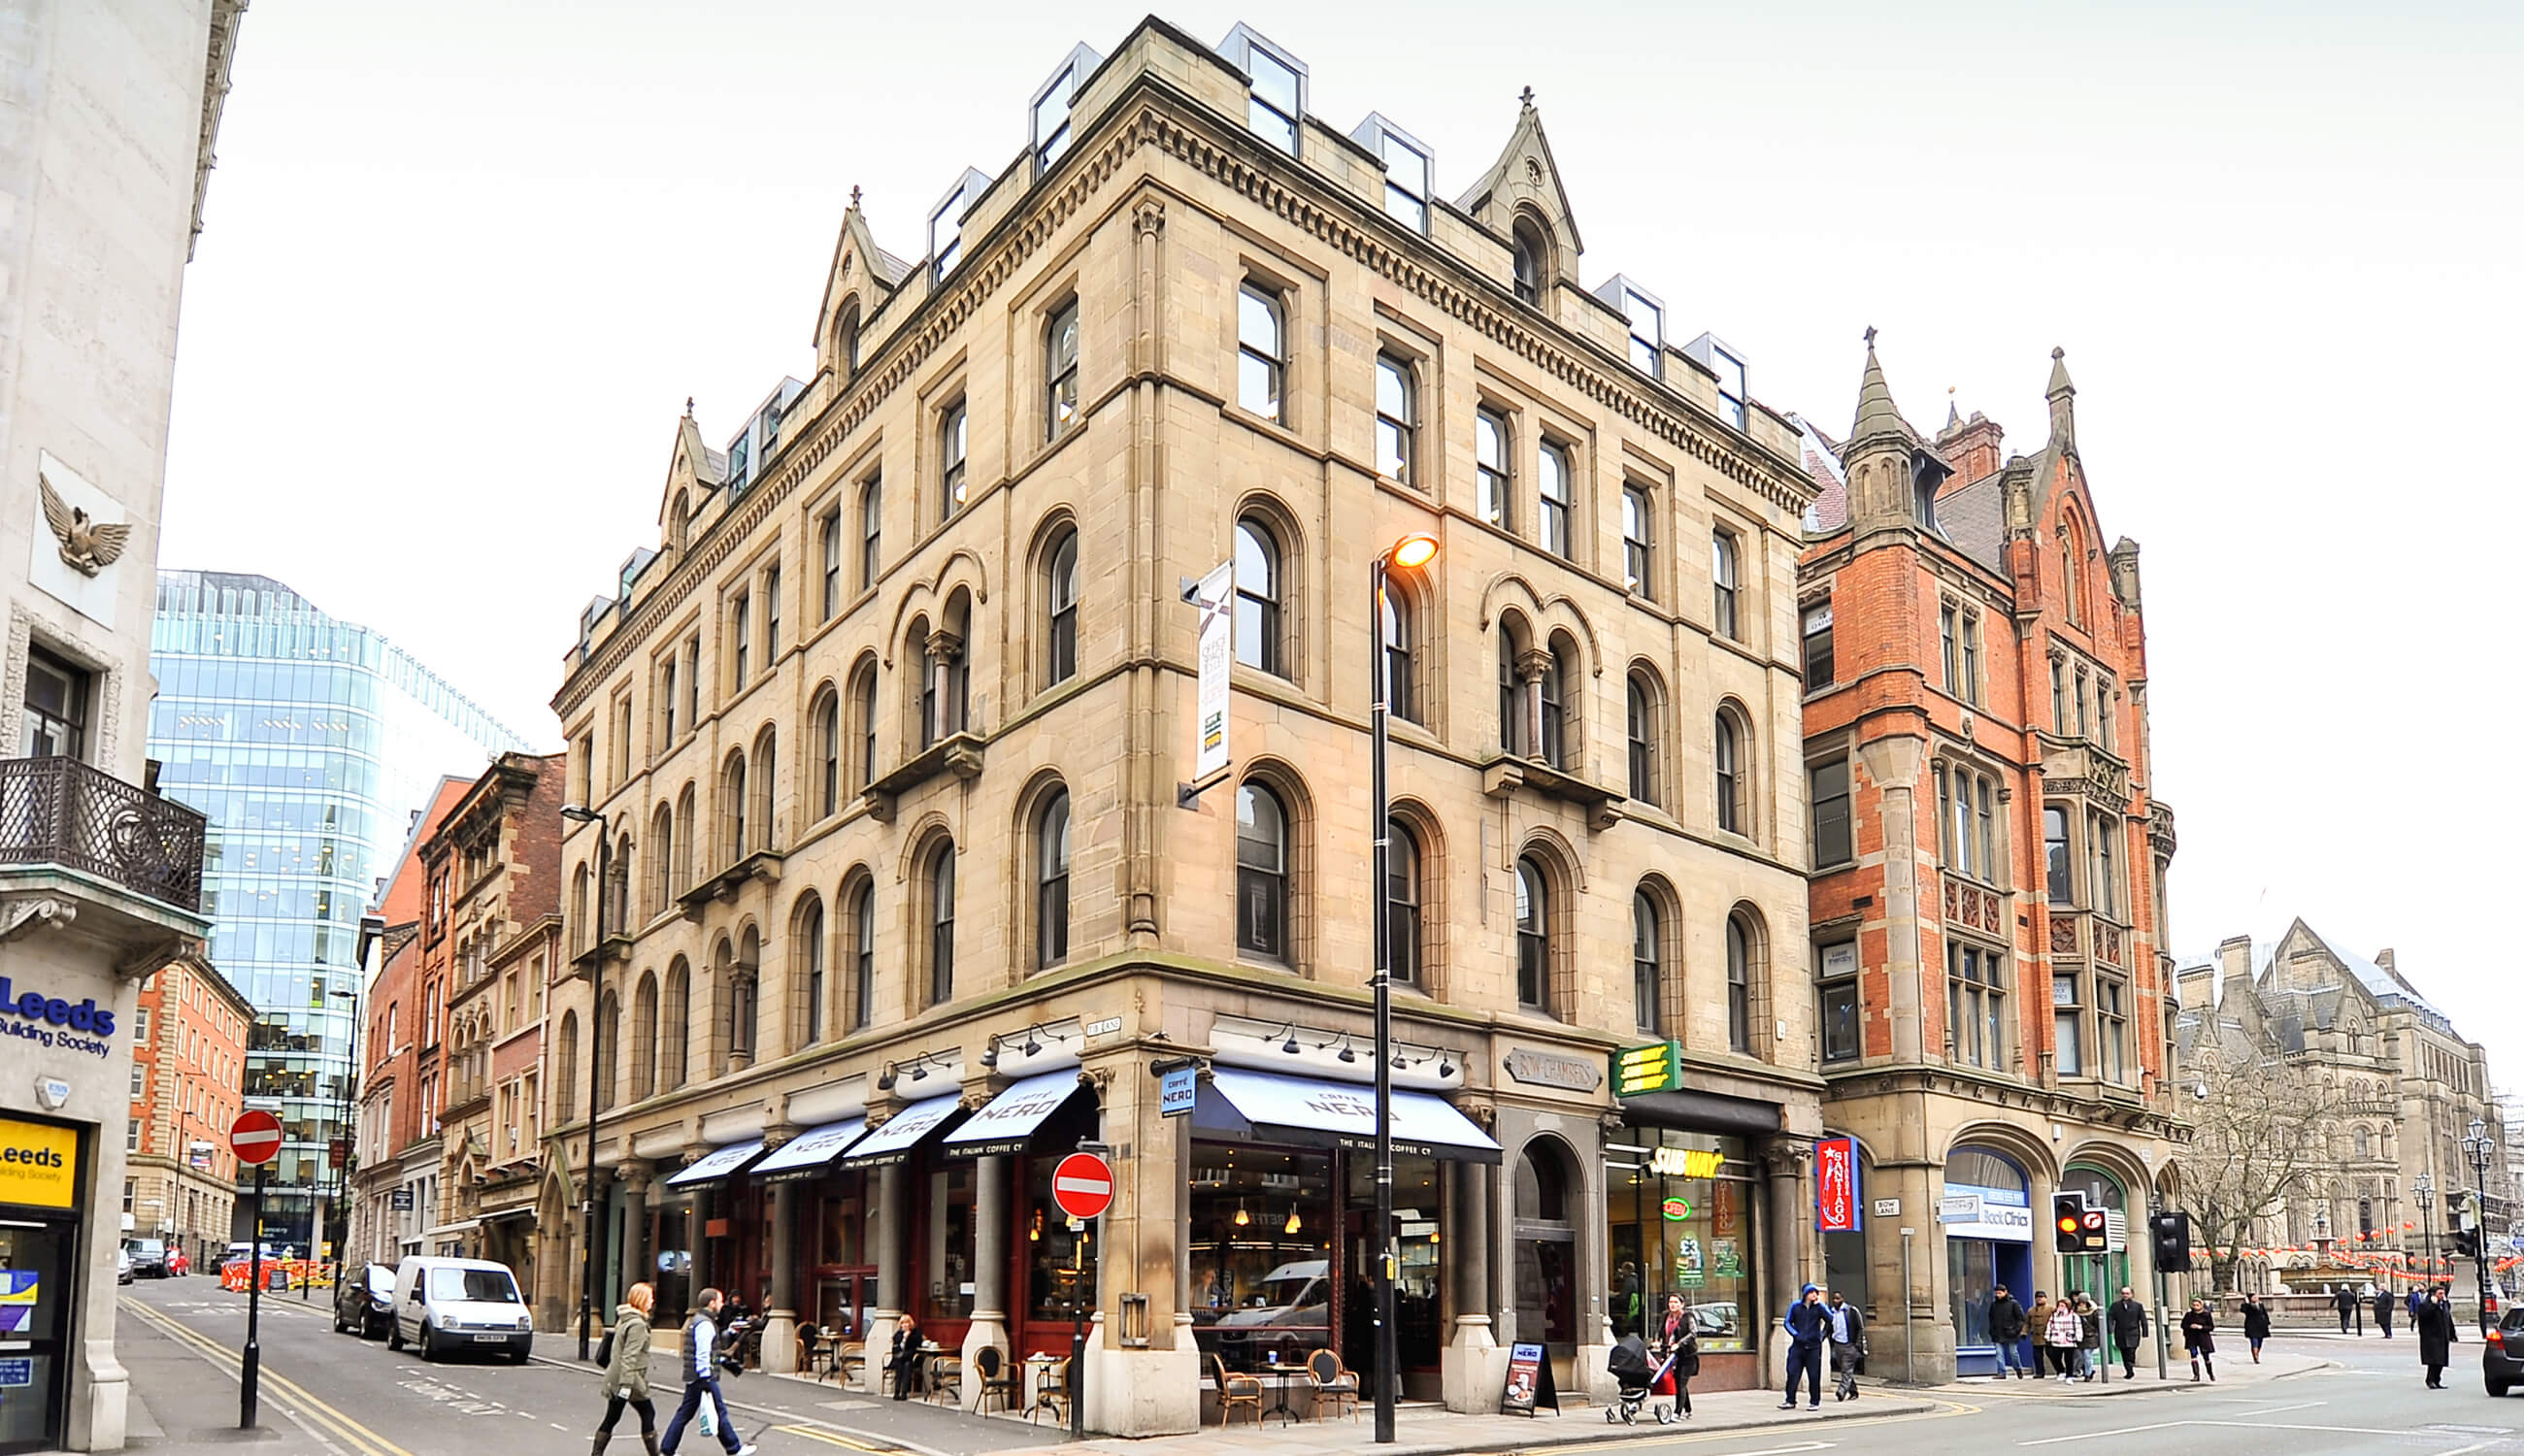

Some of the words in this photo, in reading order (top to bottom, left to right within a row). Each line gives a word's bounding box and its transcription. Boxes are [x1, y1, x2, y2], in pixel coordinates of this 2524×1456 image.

[0, 976, 116, 1038] Leeds
[56, 1031, 110, 1059] Society
[1619, 1045, 1668, 1066] SUBWAY
[1620, 1059, 1668, 1079] SUBWAY
[1621, 1073, 1669, 1093] SUBWAY
[1163, 1089, 1192, 1104] NERO
[976, 1099, 1058, 1122] NERO
[949, 1148, 960, 1157] THE
[962, 1146, 983, 1156] ITALIAN
[985, 1143, 1010, 1154] COFFEE
[1340, 1138, 1352, 1147] THE
[1358, 1141, 1376, 1149] ITALI
[1390, 1144, 1417, 1155] COFFEE
[0, 1147, 62, 1168] eeds
[1650, 1146, 1724, 1178] SUBWAY
[1834, 1151, 1845, 1223] SANTIAGO
[1663, 1202, 1686, 1216] OPEN
[1680, 1240, 1698, 1255] £3
